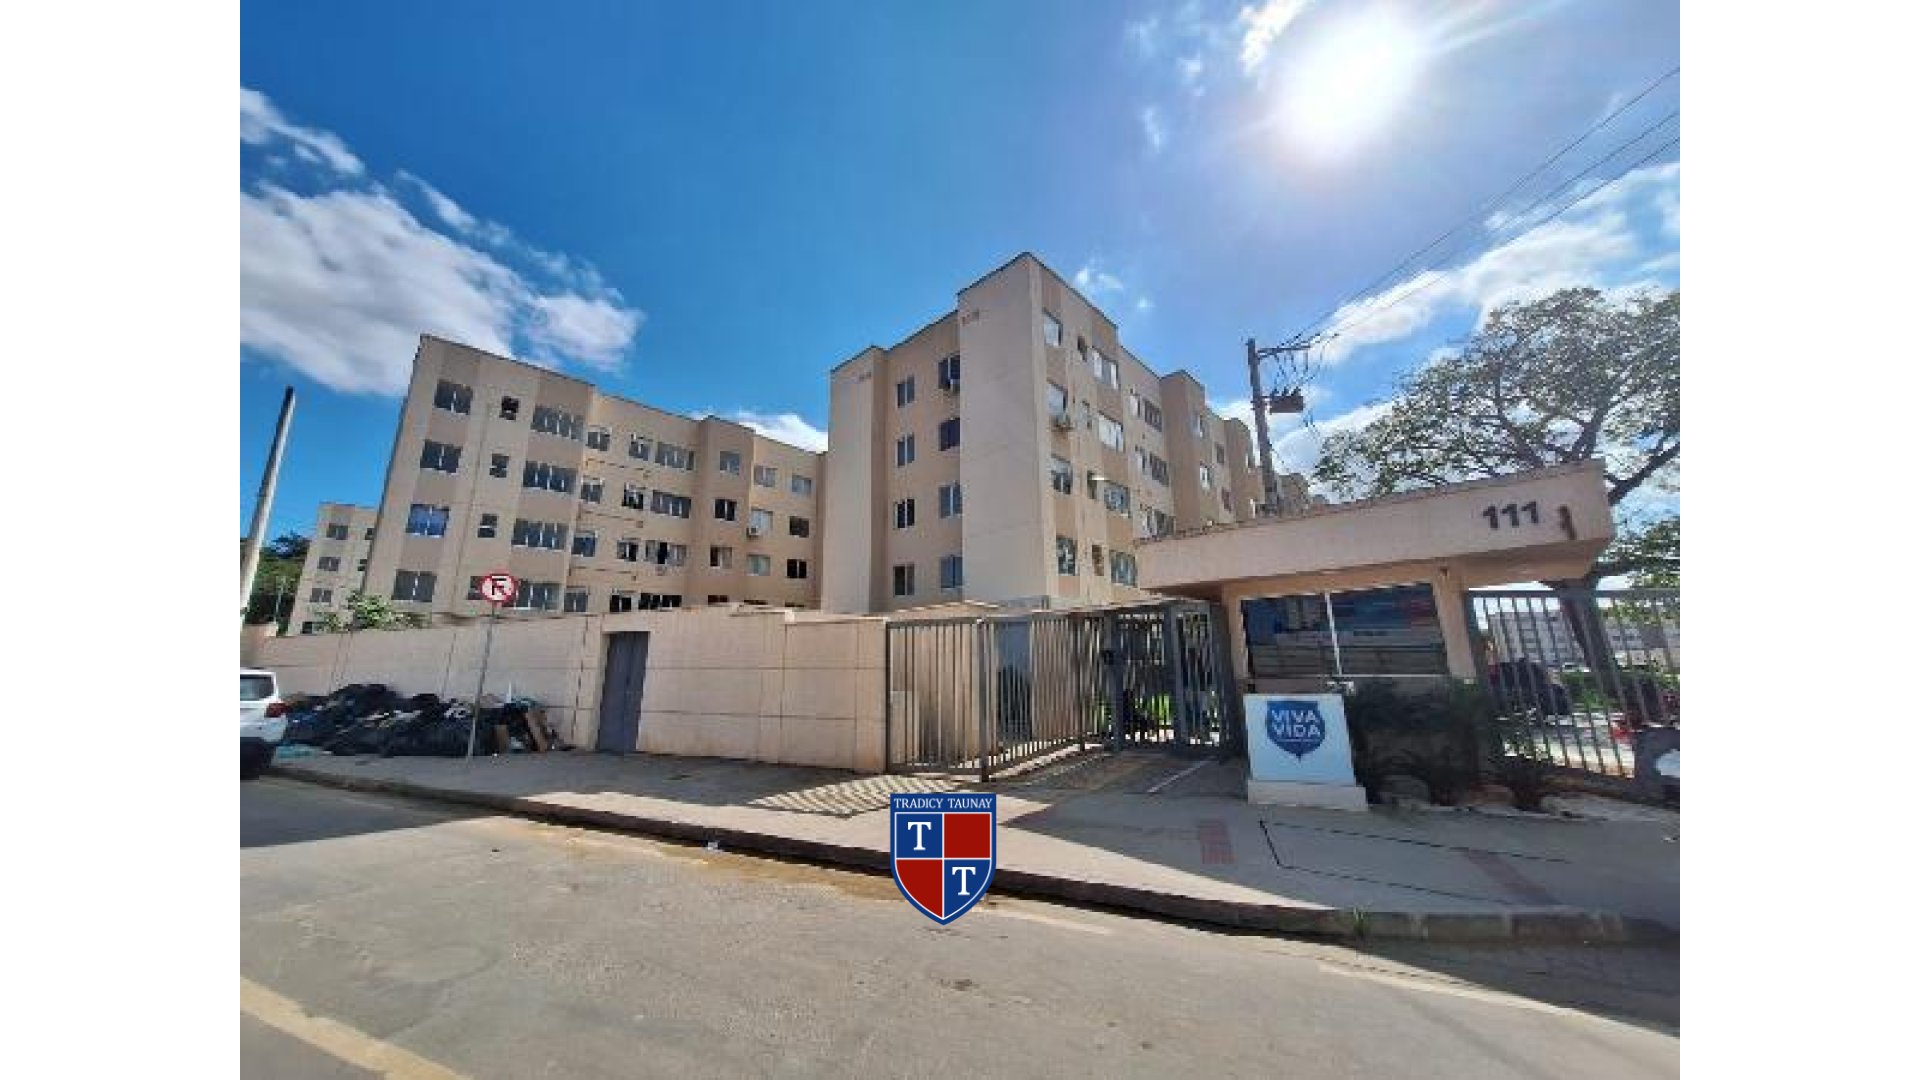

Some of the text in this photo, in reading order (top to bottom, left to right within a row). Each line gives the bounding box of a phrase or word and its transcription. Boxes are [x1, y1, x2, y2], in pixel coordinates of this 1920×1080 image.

[1483, 501, 1539, 529] 111
[1271, 709, 1320, 723] VIVA
[1271, 724, 1321, 738] VIDA
